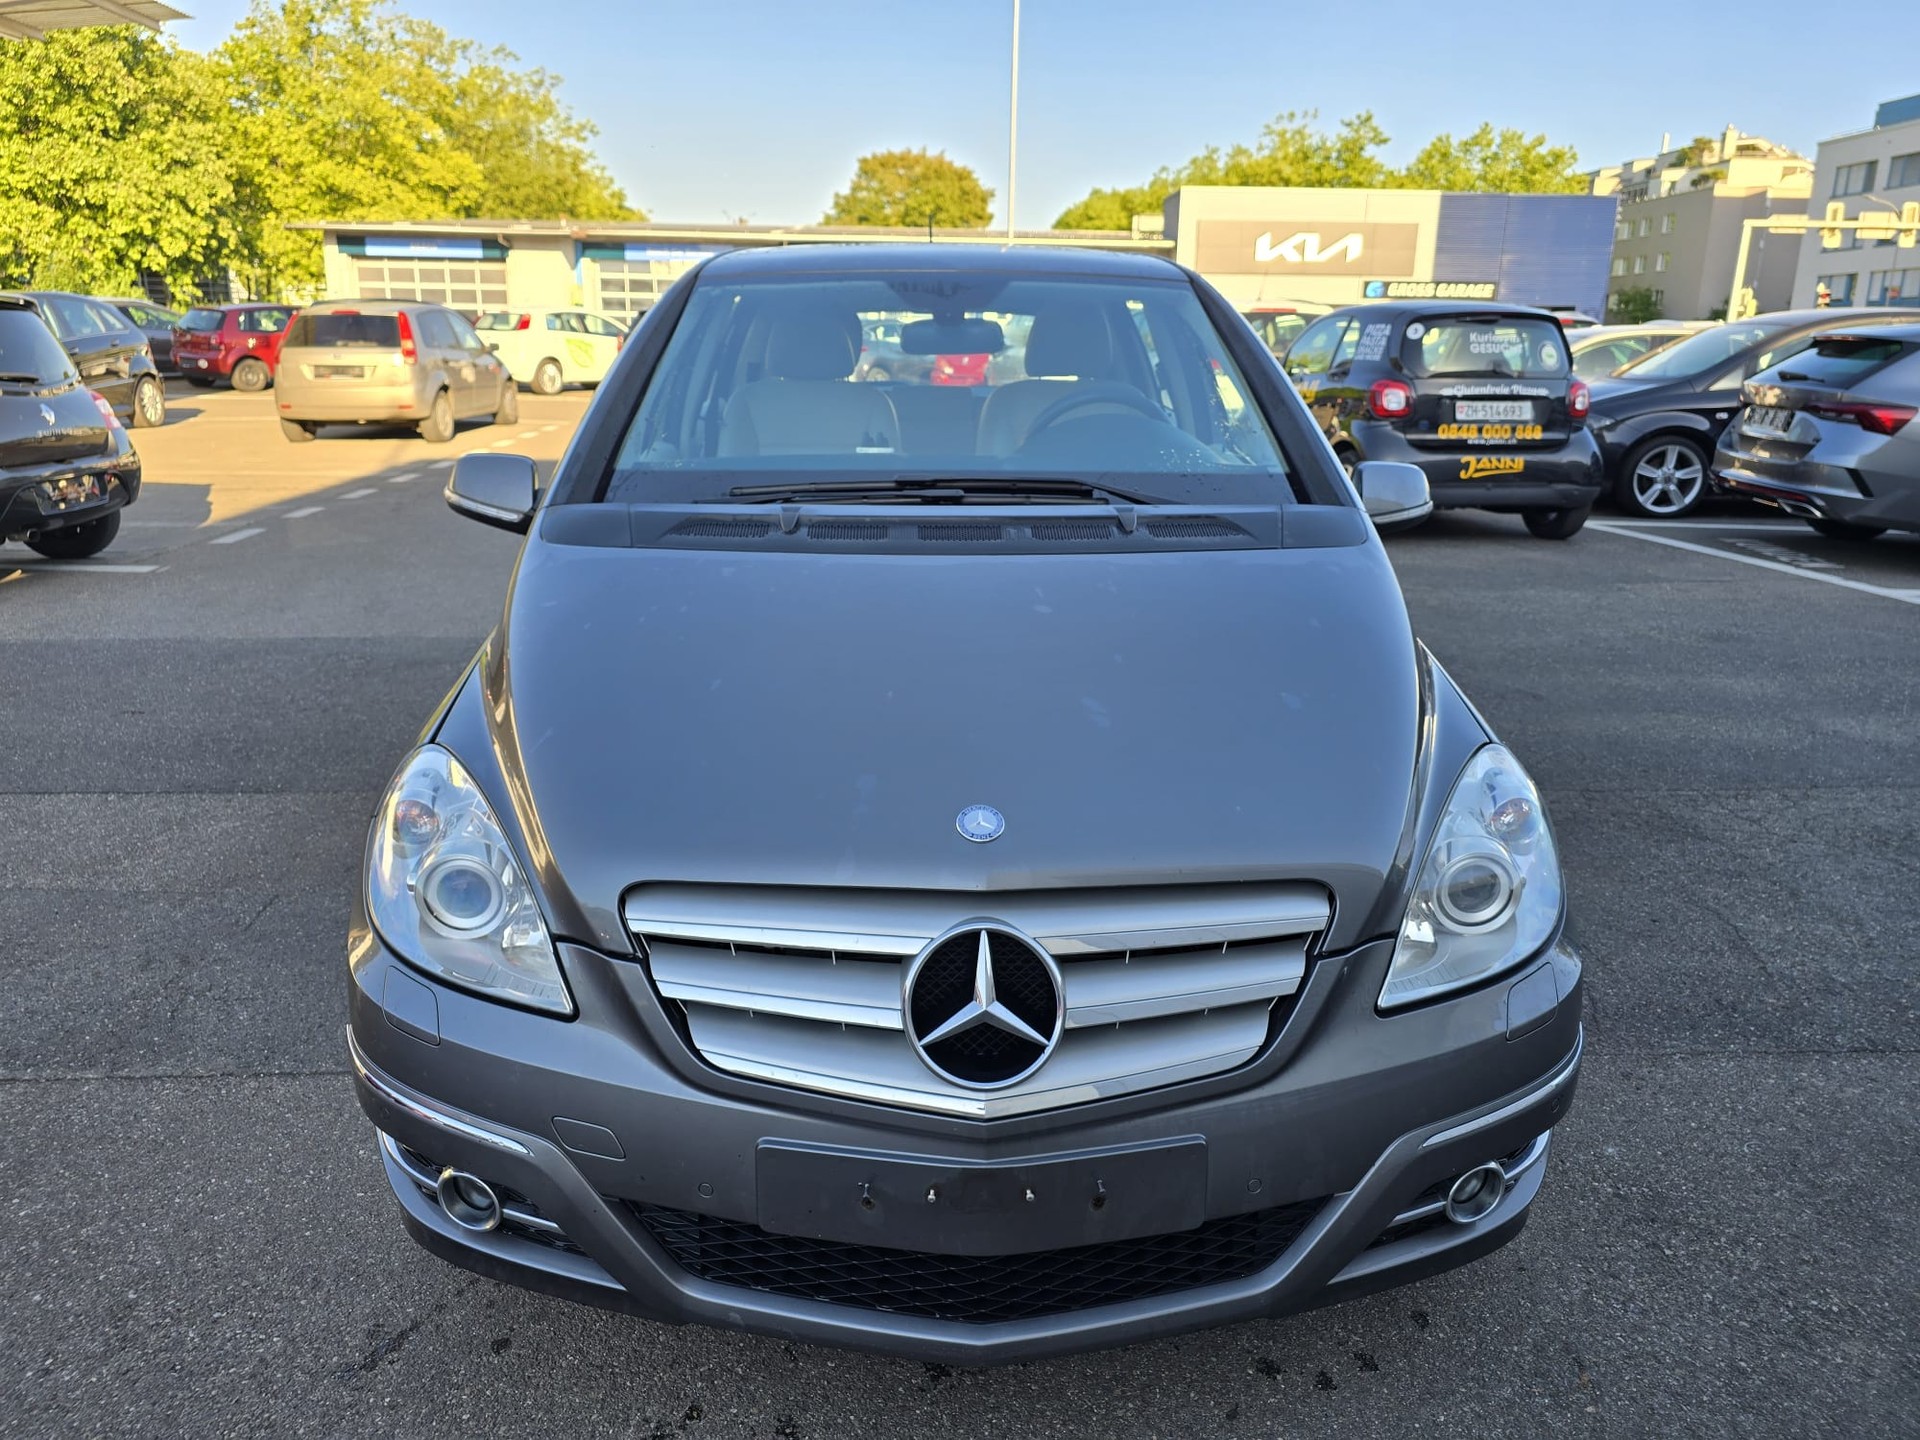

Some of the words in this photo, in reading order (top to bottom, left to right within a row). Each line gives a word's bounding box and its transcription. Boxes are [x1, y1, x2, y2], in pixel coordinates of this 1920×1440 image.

[1387, 282, 1436, 297] GROSS
[1436, 283, 1496, 298] GARAGE
[1481, 424, 1513, 440] 000
